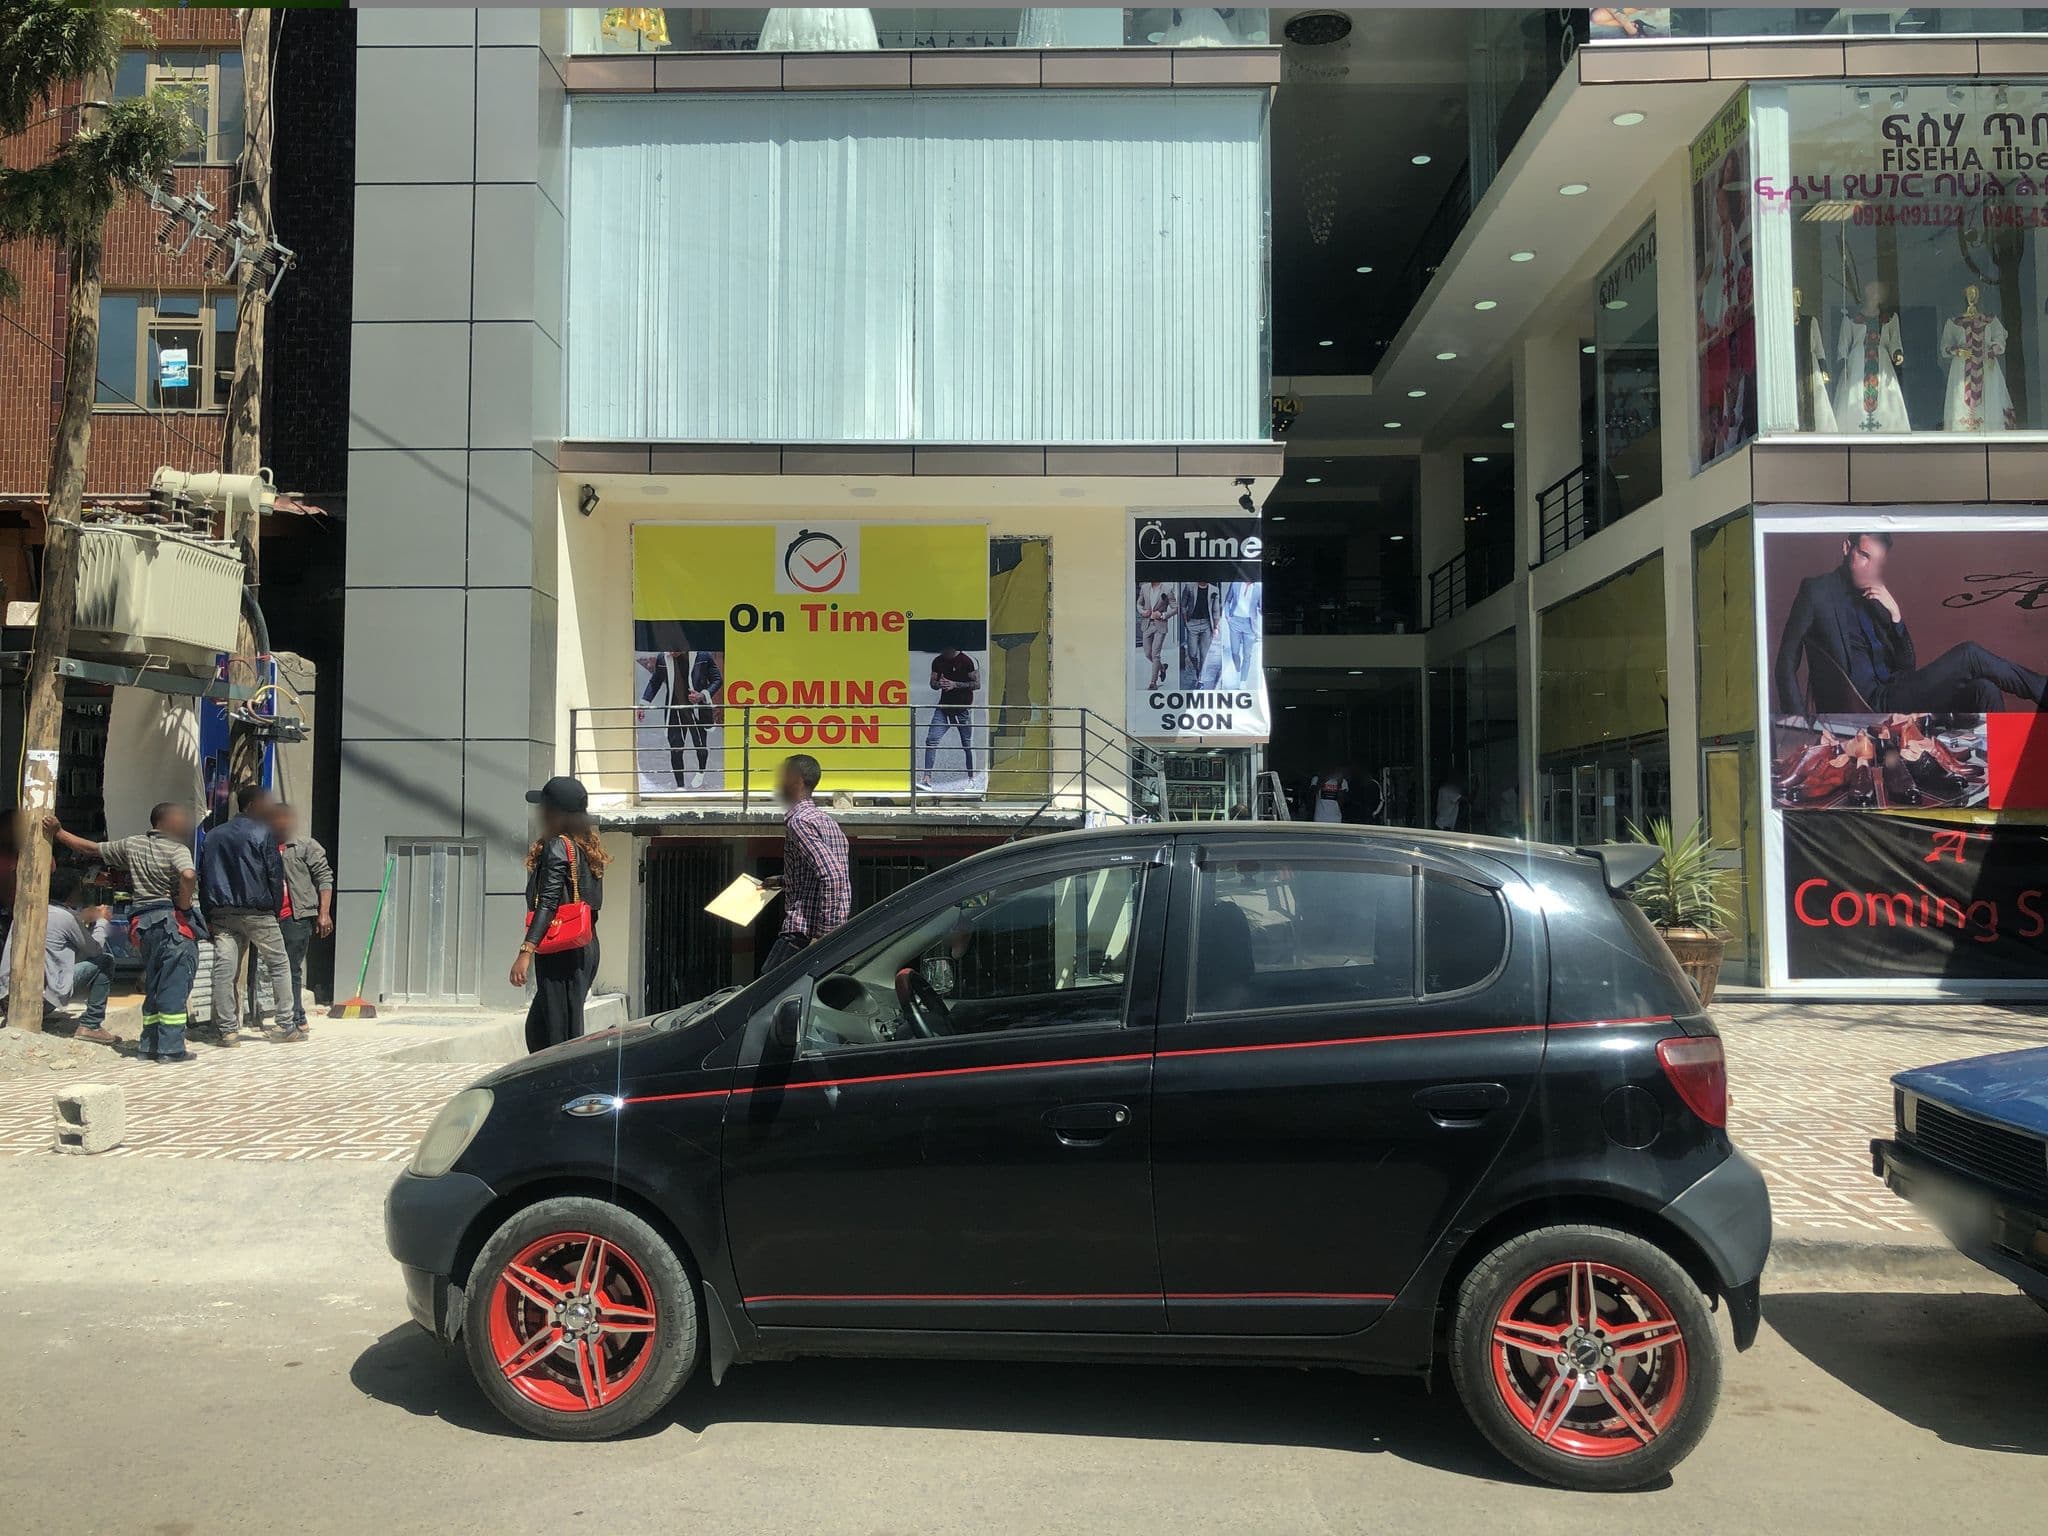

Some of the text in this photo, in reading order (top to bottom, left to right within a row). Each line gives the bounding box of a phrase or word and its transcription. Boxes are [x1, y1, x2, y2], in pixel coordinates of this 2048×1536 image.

[1882, 147, 1984, 172] FISEHA
[1184, 530, 1263, 559] Time
[729, 602, 786, 634] On
[727, 679, 908, 710] COMING
[1148, 692, 1253, 710] COMING
[754, 715, 880, 745] SOON
[1160, 713, 1233, 731] SOON
[1794, 878, 2000, 943] Coming
